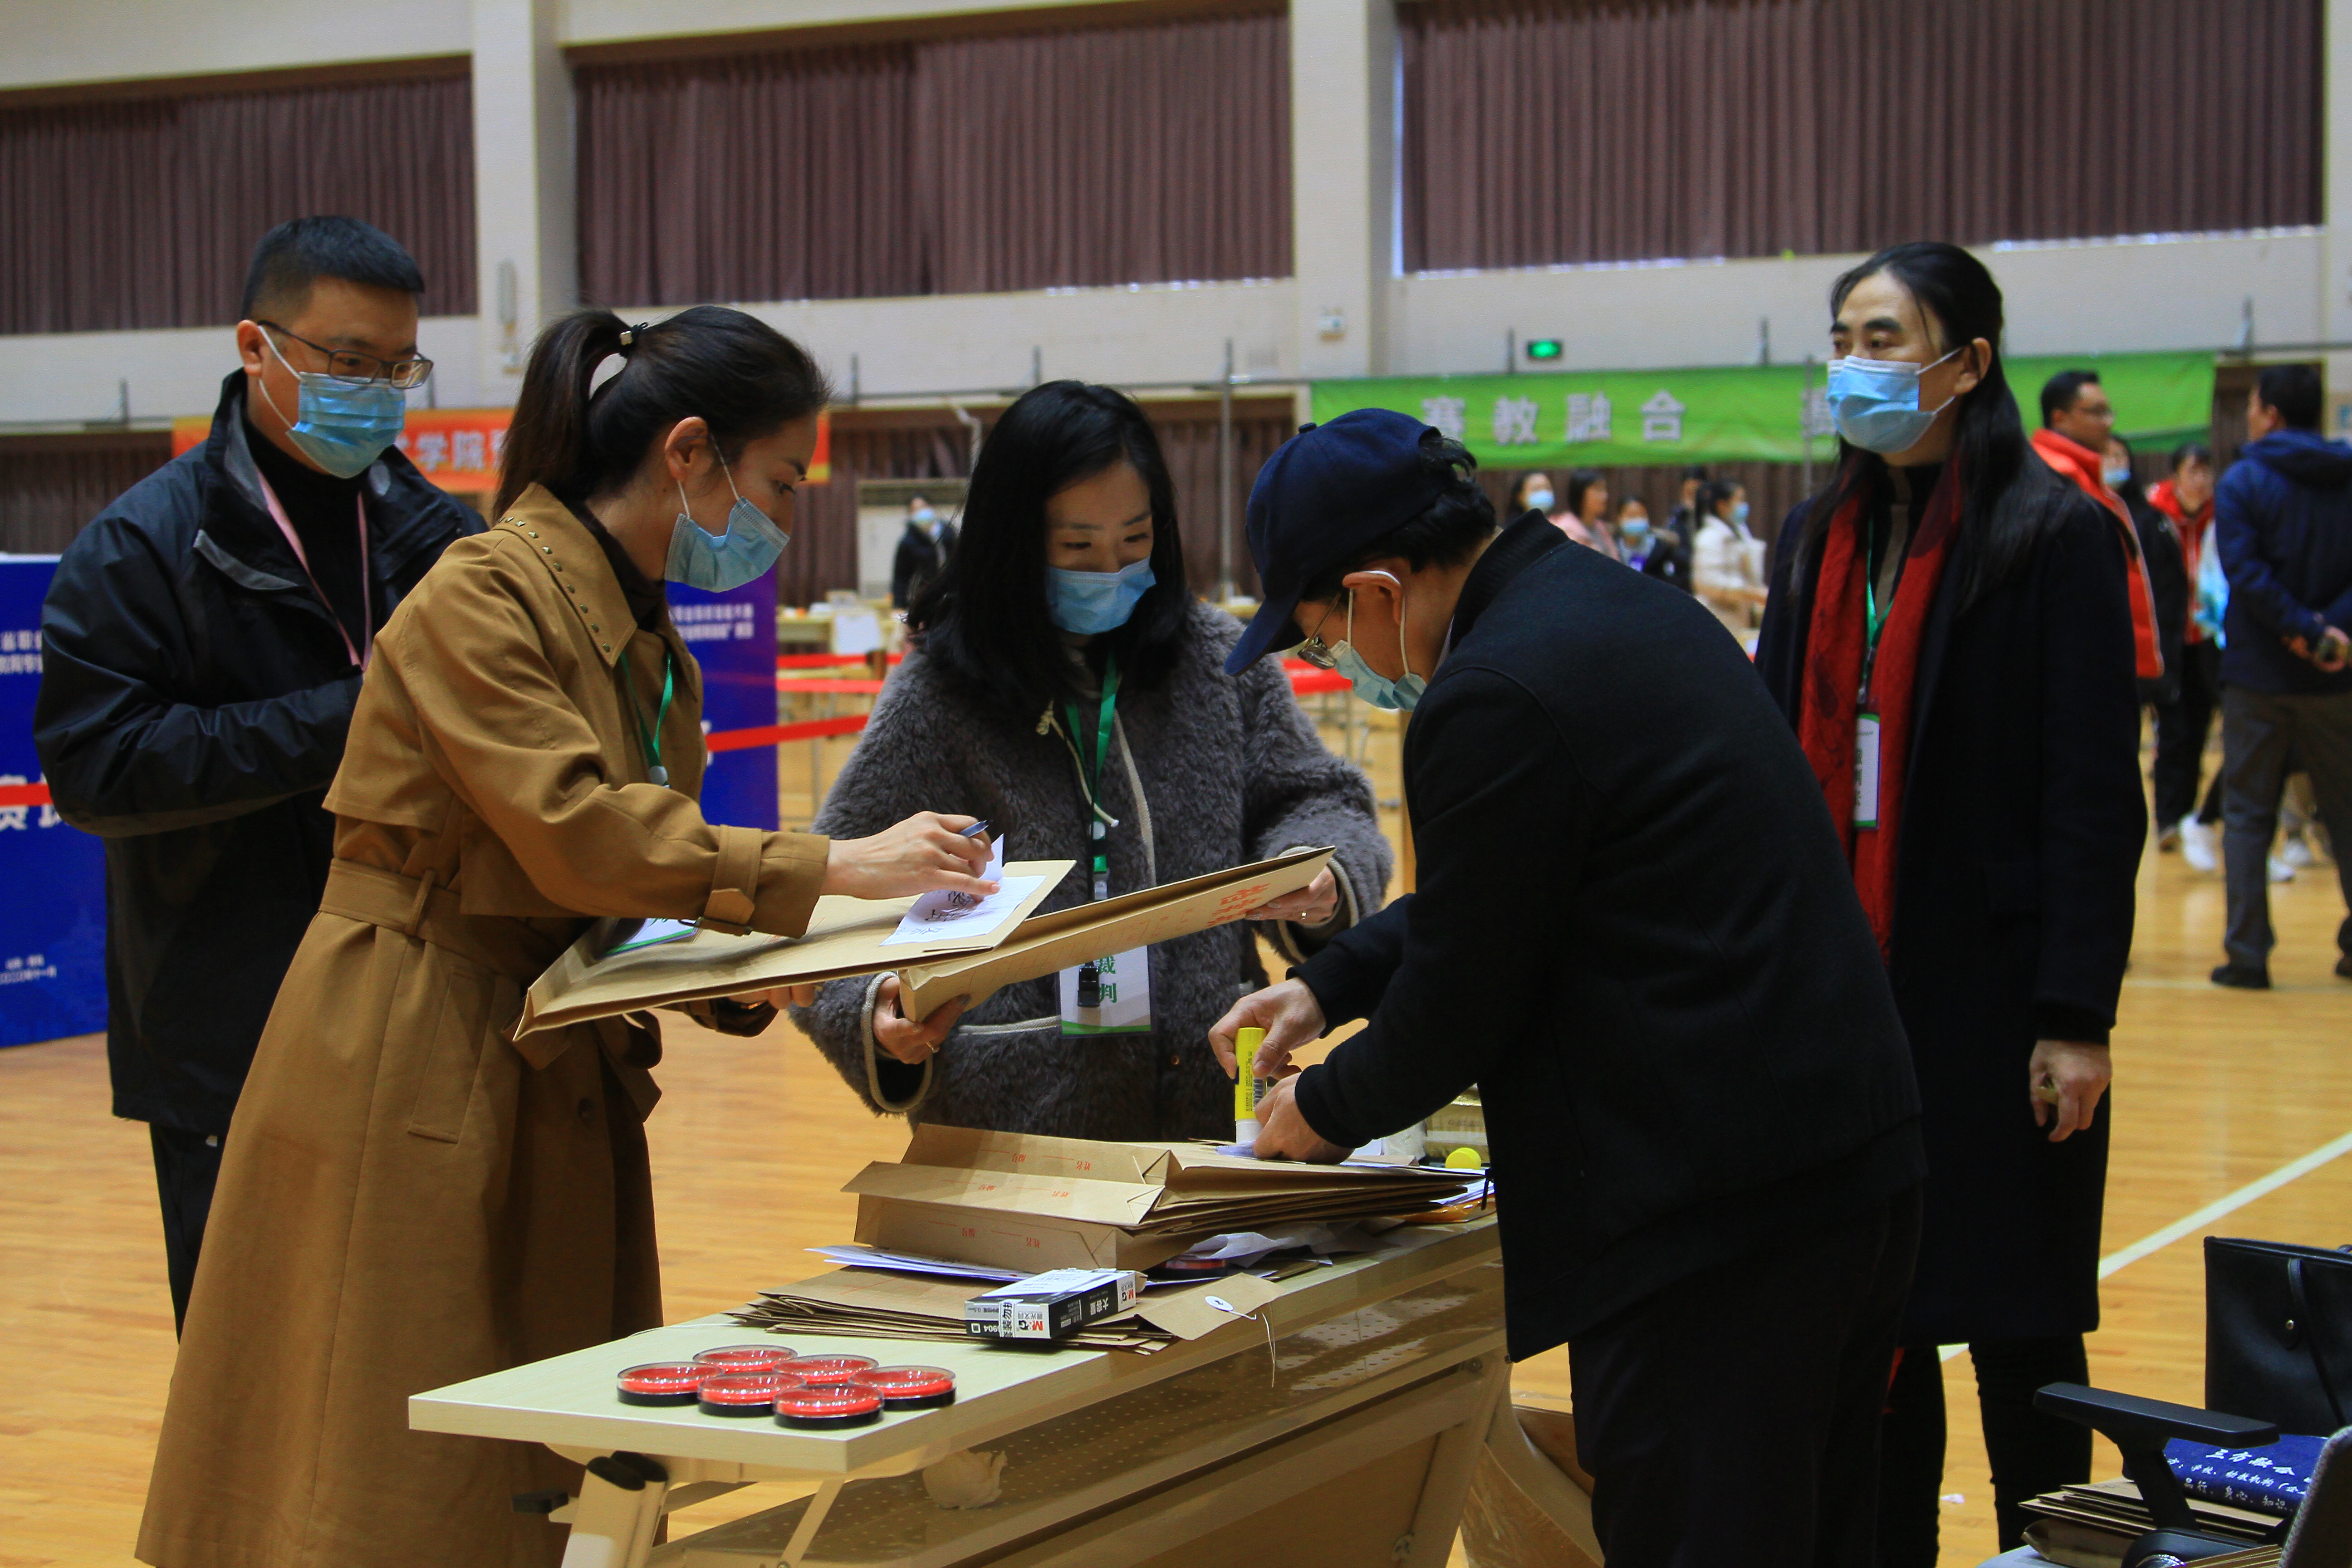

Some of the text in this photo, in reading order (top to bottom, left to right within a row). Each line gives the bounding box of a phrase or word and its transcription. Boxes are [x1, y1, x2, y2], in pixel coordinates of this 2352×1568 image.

[1421, 390, 1686, 445] 赛教融合
[1011, 1153, 1091, 1171] 姓名 编号
[1052, 1190, 1069, 1198] 姓名
[961, 1227, 1040, 1248] 姓名 编号
[1090, 1297, 1109, 1316] 大容量
